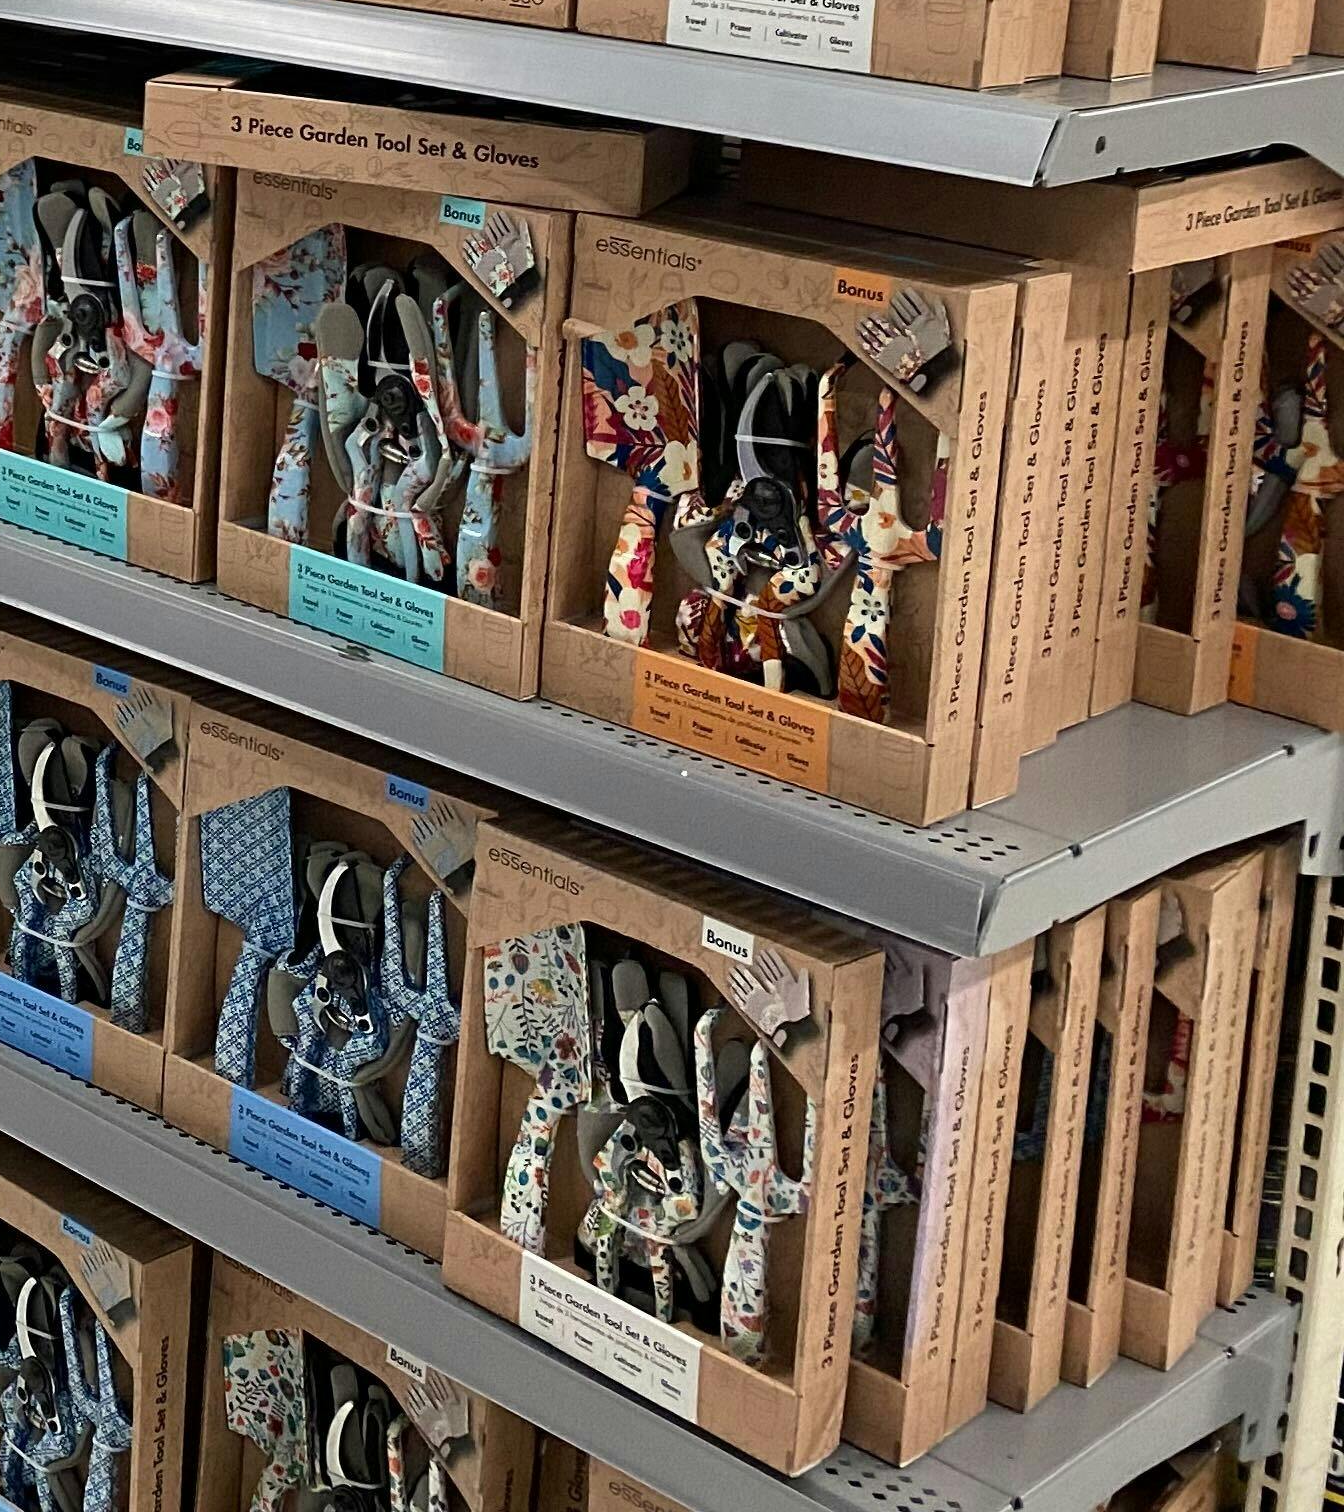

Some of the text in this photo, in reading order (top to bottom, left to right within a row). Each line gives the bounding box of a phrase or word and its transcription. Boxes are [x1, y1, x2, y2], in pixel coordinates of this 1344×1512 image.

[231, 115, 539, 169] 3 Piece Garden Tool Set & Gloves
[252, 172, 337, 200] essentials
[443, 205, 481, 225] Bonus
[595, 236, 699, 272] essentials
[837, 278, 884, 302] Bonus
[948, 391, 988, 723] 3 Piece Garden Tool Set & Gloves
[96, 671, 129, 693] Bonus
[200, 720, 283, 762] essentials
[388, 782, 425, 807] Bonus
[488, 845, 582, 896] essentials
[707, 927, 750, 960] Bonus
